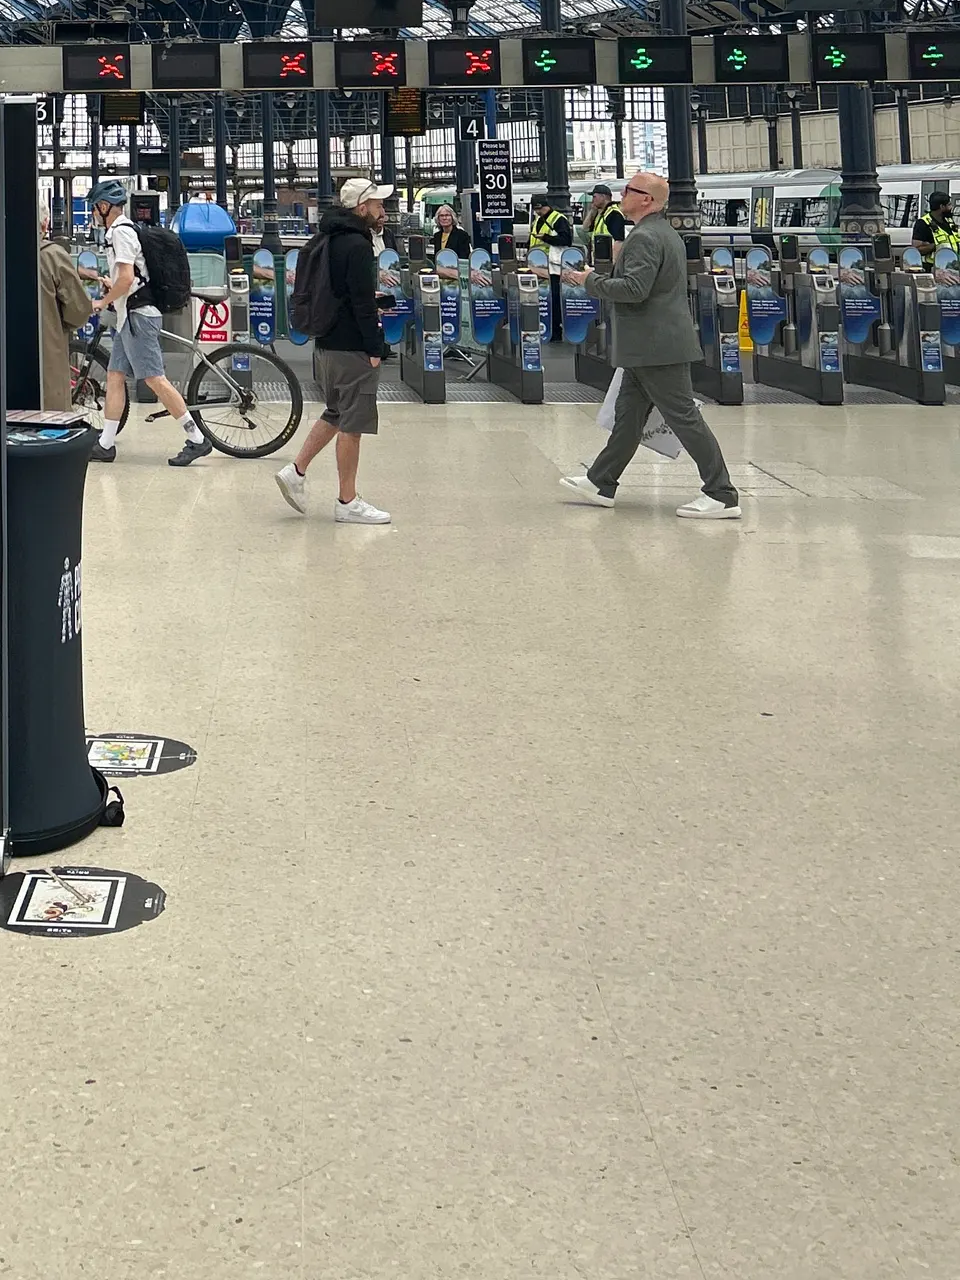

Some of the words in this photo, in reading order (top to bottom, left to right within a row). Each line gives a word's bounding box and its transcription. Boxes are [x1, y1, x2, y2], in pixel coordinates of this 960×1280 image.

[36, 102, 46, 120] 3
[466, 120, 478, 136] 4
[485, 174, 507, 189] 30
